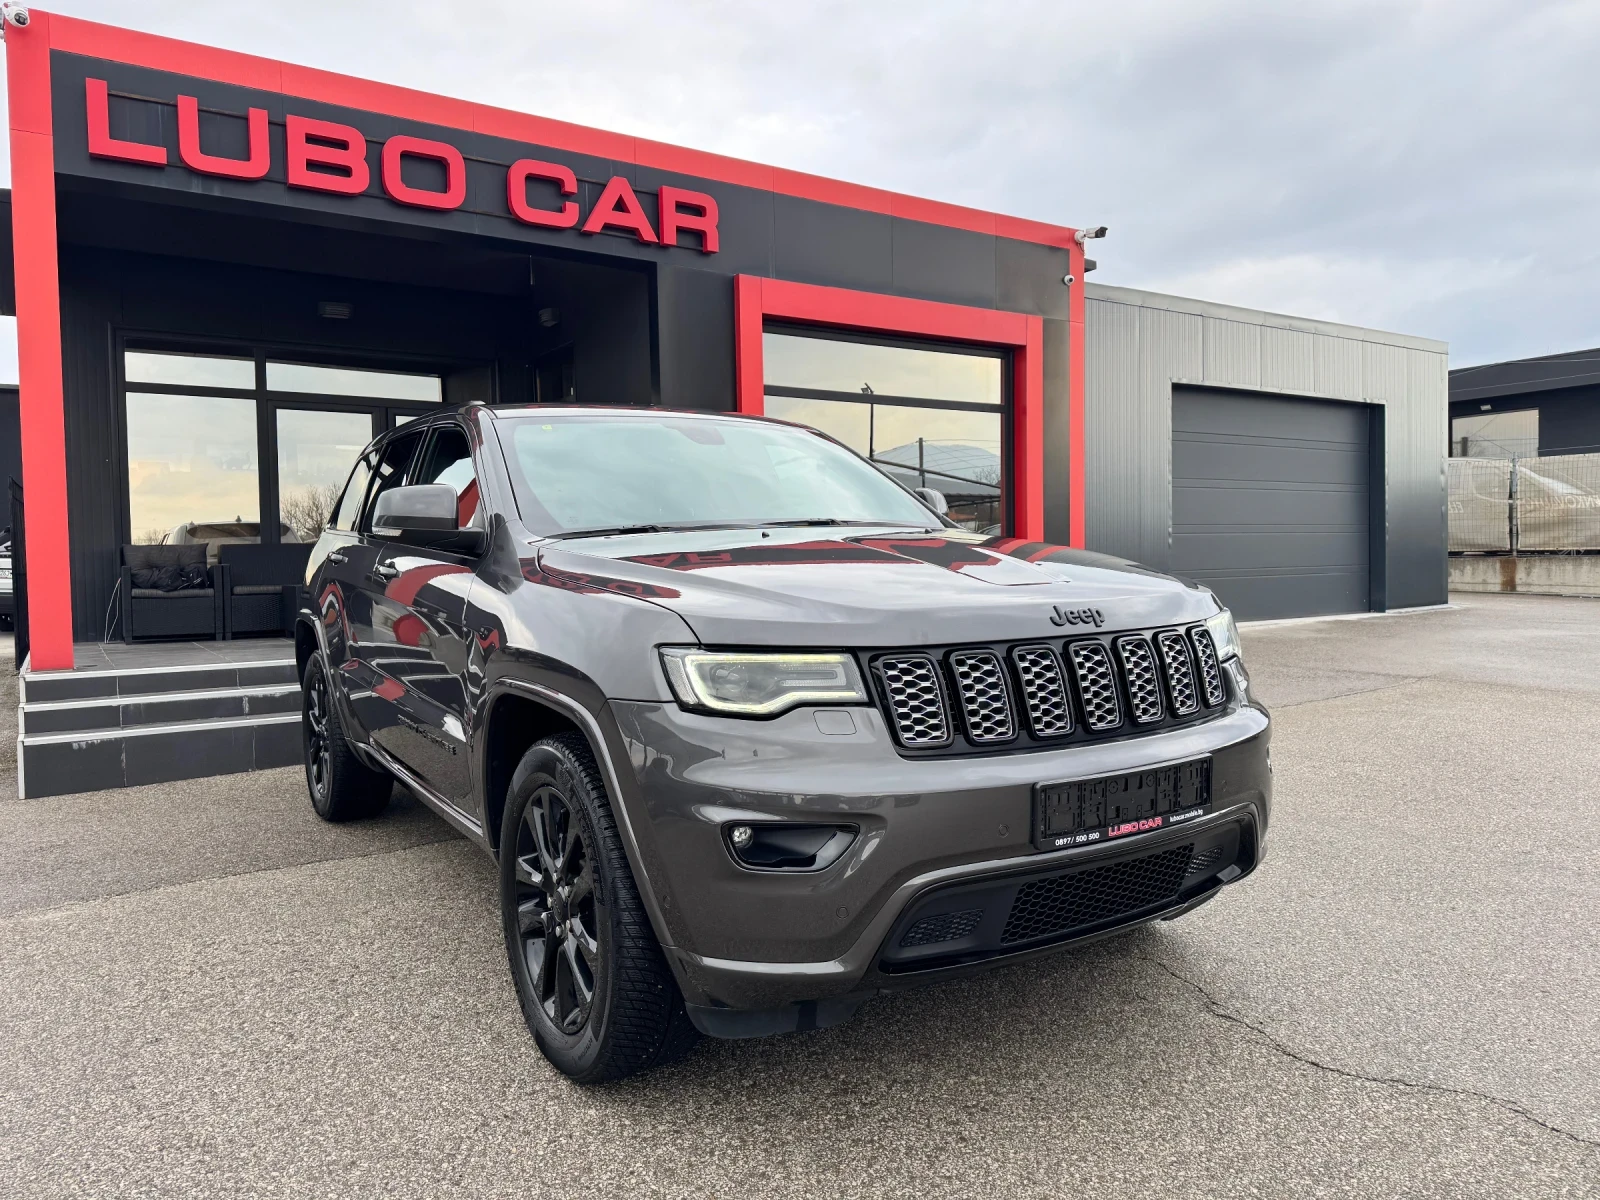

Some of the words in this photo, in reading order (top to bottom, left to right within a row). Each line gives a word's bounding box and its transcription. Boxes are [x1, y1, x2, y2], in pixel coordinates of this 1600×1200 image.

[85, 78, 468, 212] LUBO
[507, 158, 720, 254] CAR
[1049, 605, 1105, 628] Jeep
[1109, 822, 1139, 836] LUBO
[1139, 816, 1162, 830] CAR
[1055, 836, 1074, 846] 0897/
[1075, 834, 1087, 843] 500
[1088, 832, 1100, 841] 500
